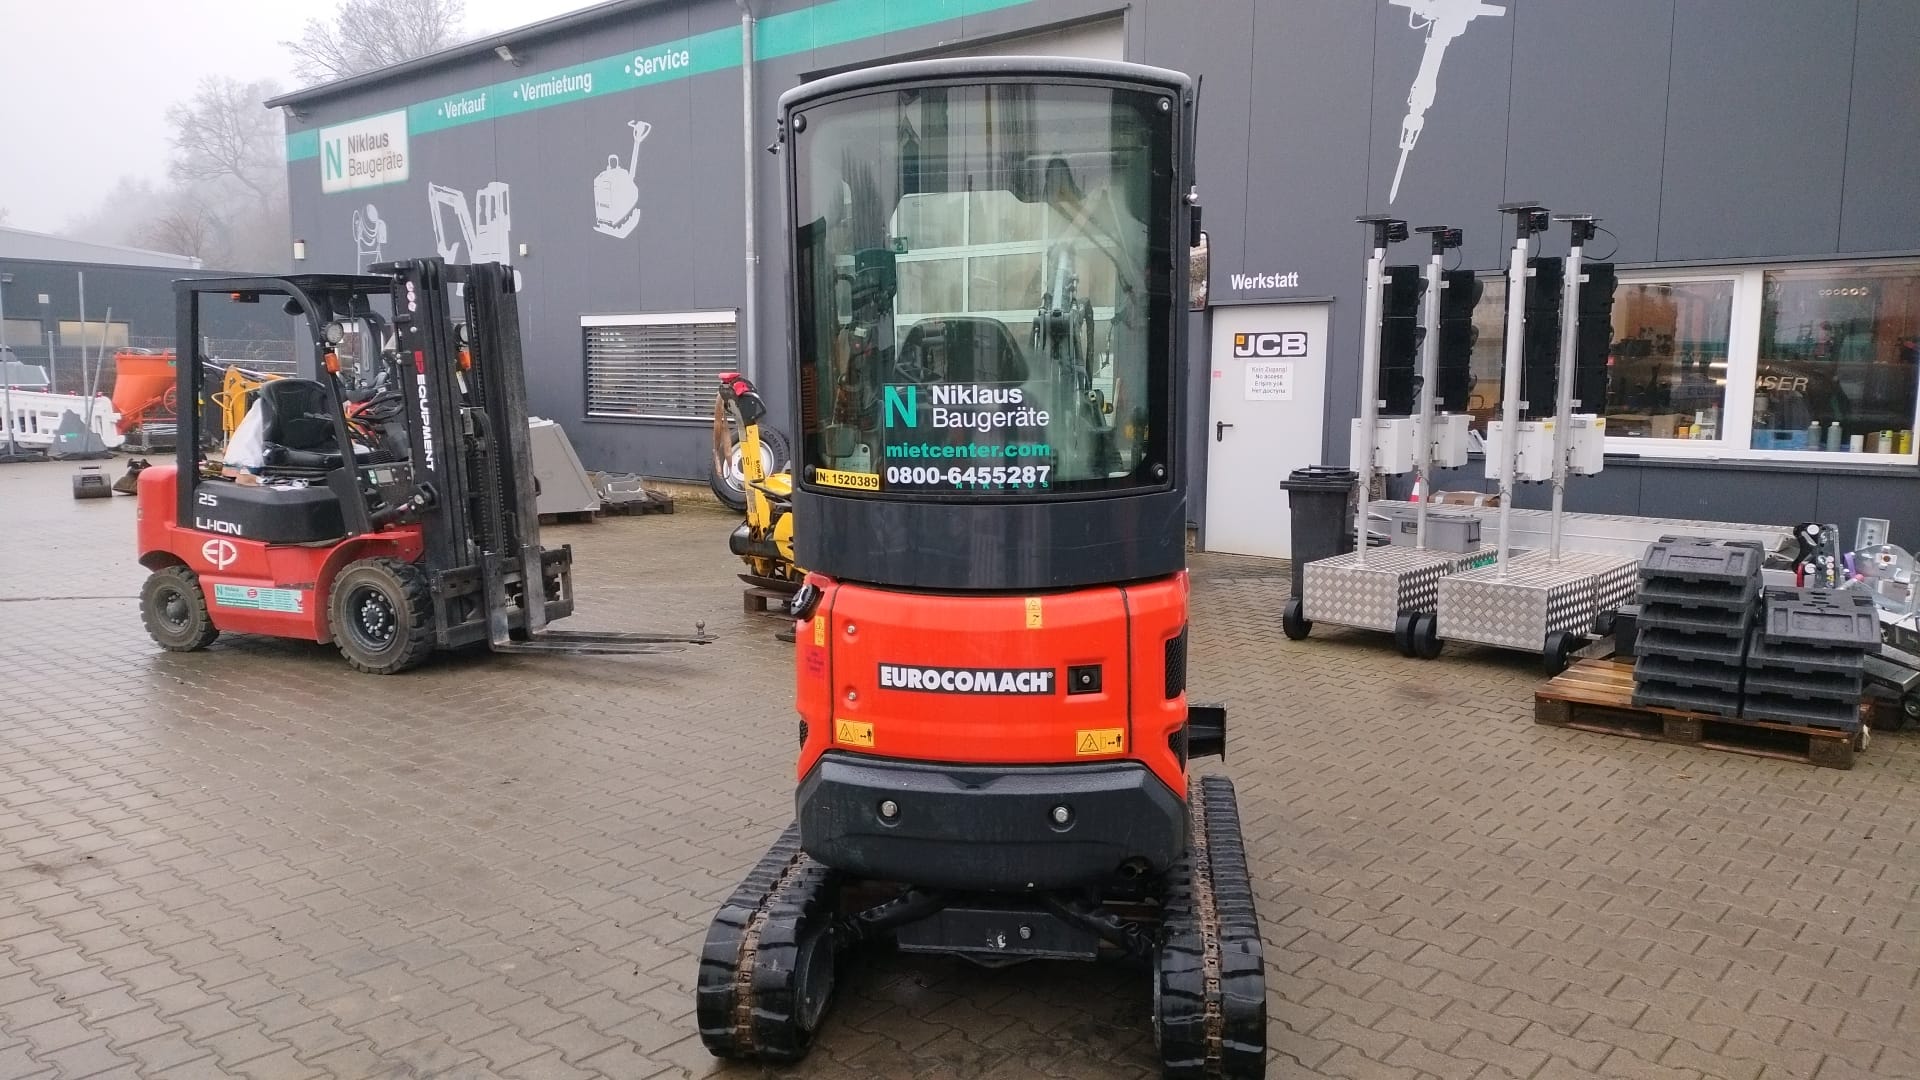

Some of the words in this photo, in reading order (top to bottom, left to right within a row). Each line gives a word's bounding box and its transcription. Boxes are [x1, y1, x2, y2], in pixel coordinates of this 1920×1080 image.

[634, 49, 689, 76] Service
[521, 72, 592, 101] Vermietung
[444, 93, 486, 119] Verkauf
[347, 133, 389, 155] Niklaus
[325, 138, 342, 180] N
[348, 151, 404, 178] Baugeräte
[1231, 272, 1299, 290] Werkstatt
[1235, 333, 1306, 356] JCB
[932, 384, 1023, 405] Niklaus
[884, 385, 917, 428] N
[932, 407, 1050, 432] Baugeräte
[886, 442, 1050, 458] mietcenter.com
[816, 471, 829, 483] IN:
[832, 474, 878, 488] 1520389
[886, 465, 1051, 485] 0800-6455287
[199, 492, 218, 507] 25
